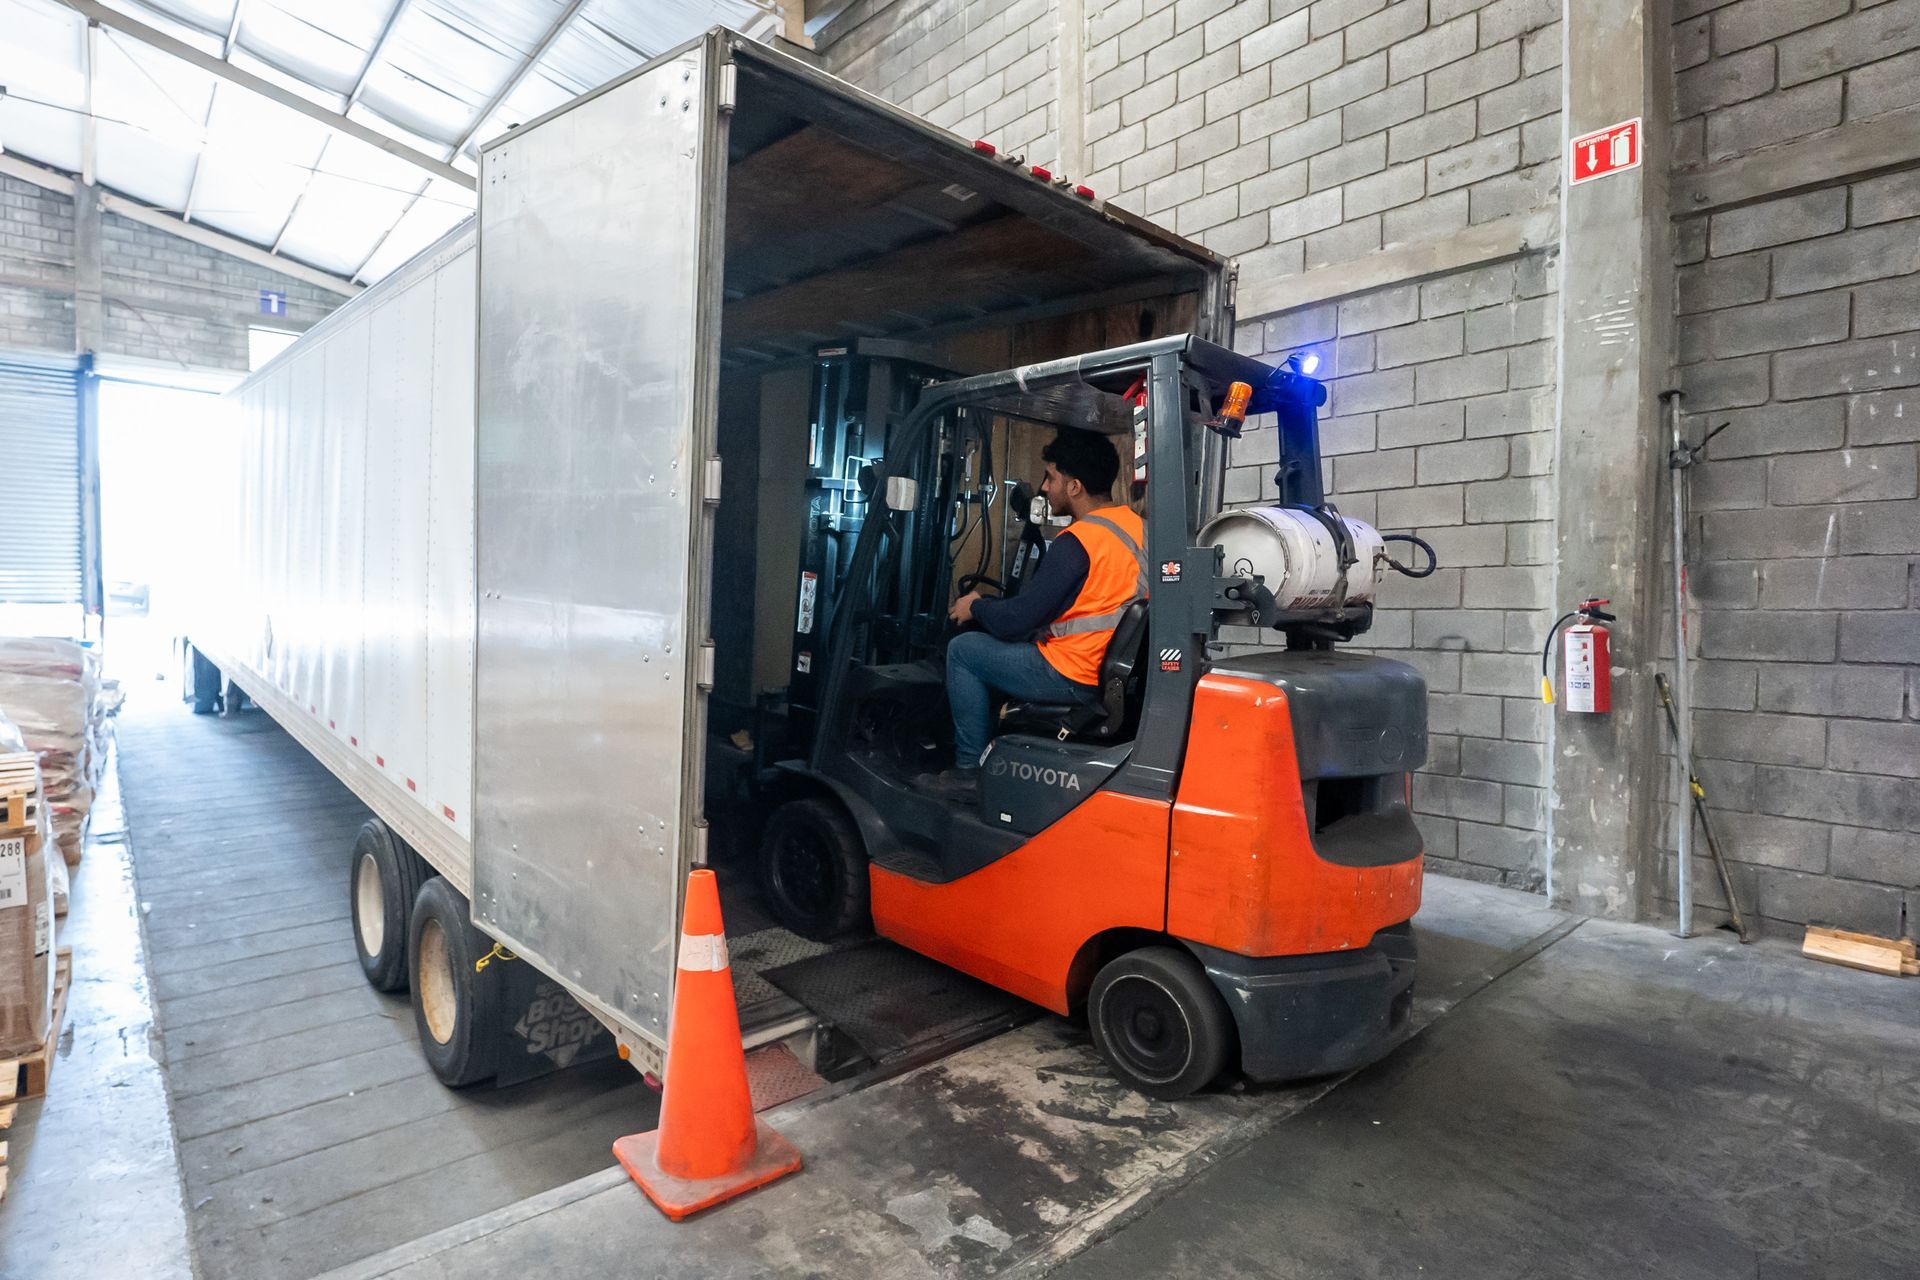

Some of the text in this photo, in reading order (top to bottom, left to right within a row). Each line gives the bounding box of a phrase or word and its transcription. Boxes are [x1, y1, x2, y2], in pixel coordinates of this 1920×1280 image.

[1578, 134, 1609, 149] EXTINTOR
[269, 294, 278, 313] 1
[1162, 561, 1181, 575] SAS
[1010, 761, 1080, 791] TOYOTA
